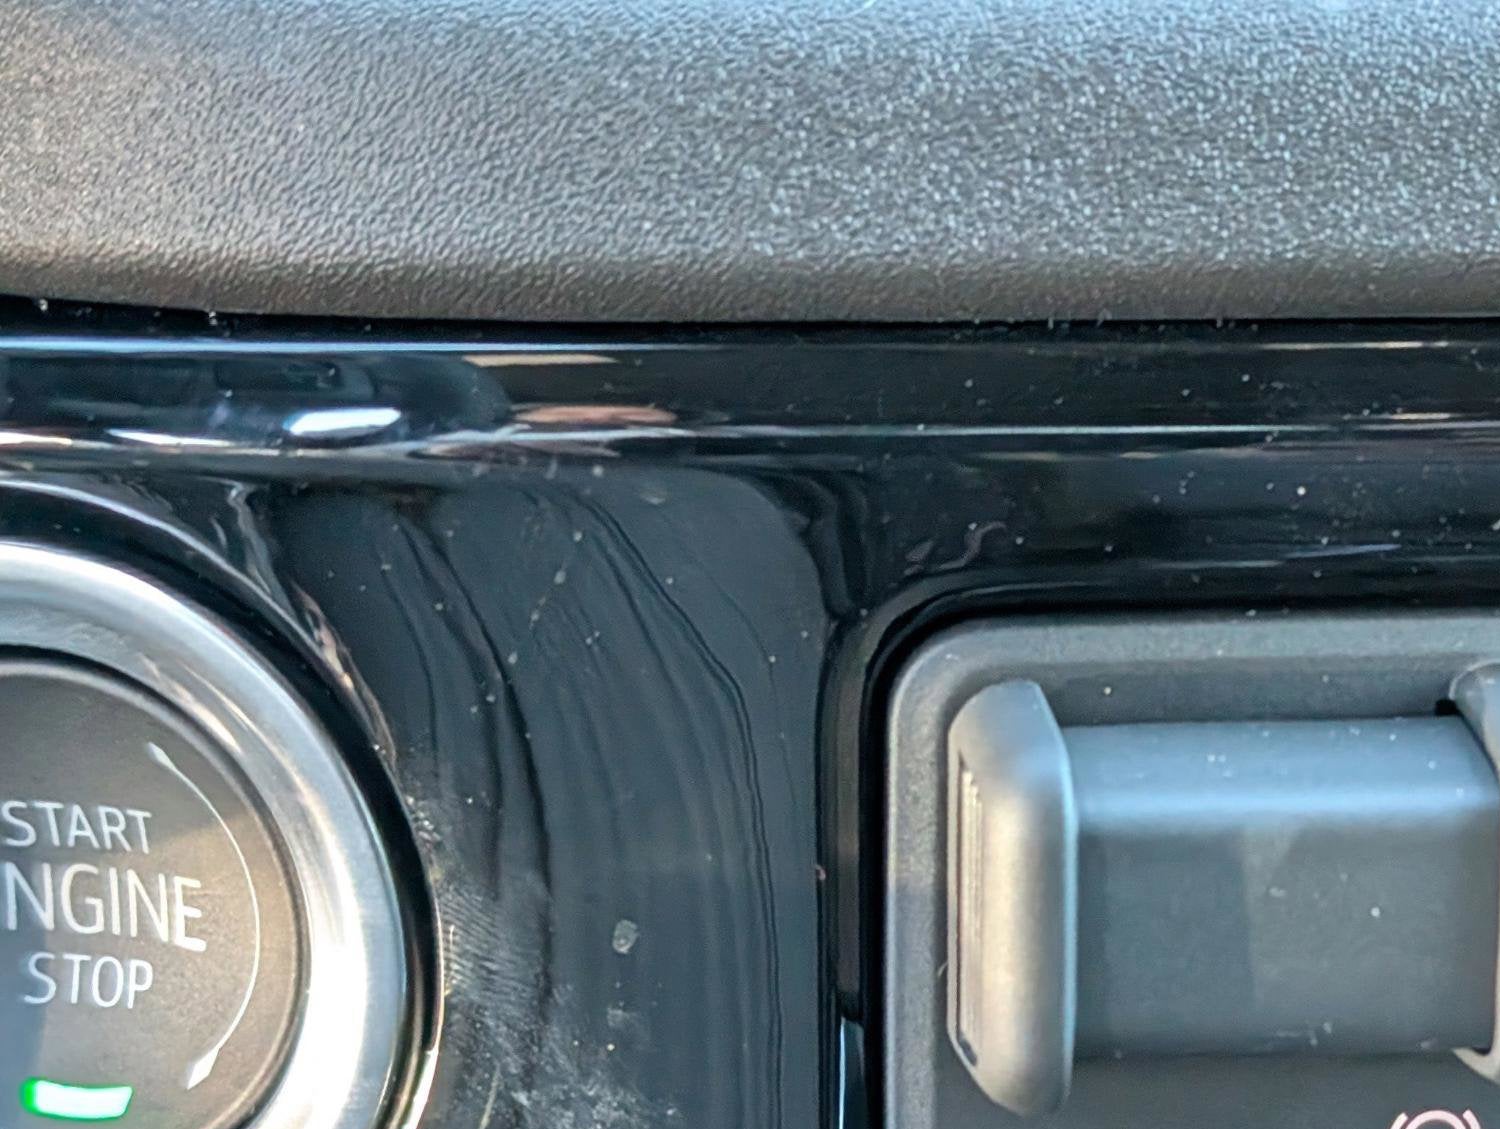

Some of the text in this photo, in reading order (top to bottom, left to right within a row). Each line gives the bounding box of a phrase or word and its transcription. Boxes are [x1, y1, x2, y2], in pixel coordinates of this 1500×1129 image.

[1, 800, 152, 853] START
[1, 861, 207, 952] NGINE
[24, 951, 154, 1009] STOP
